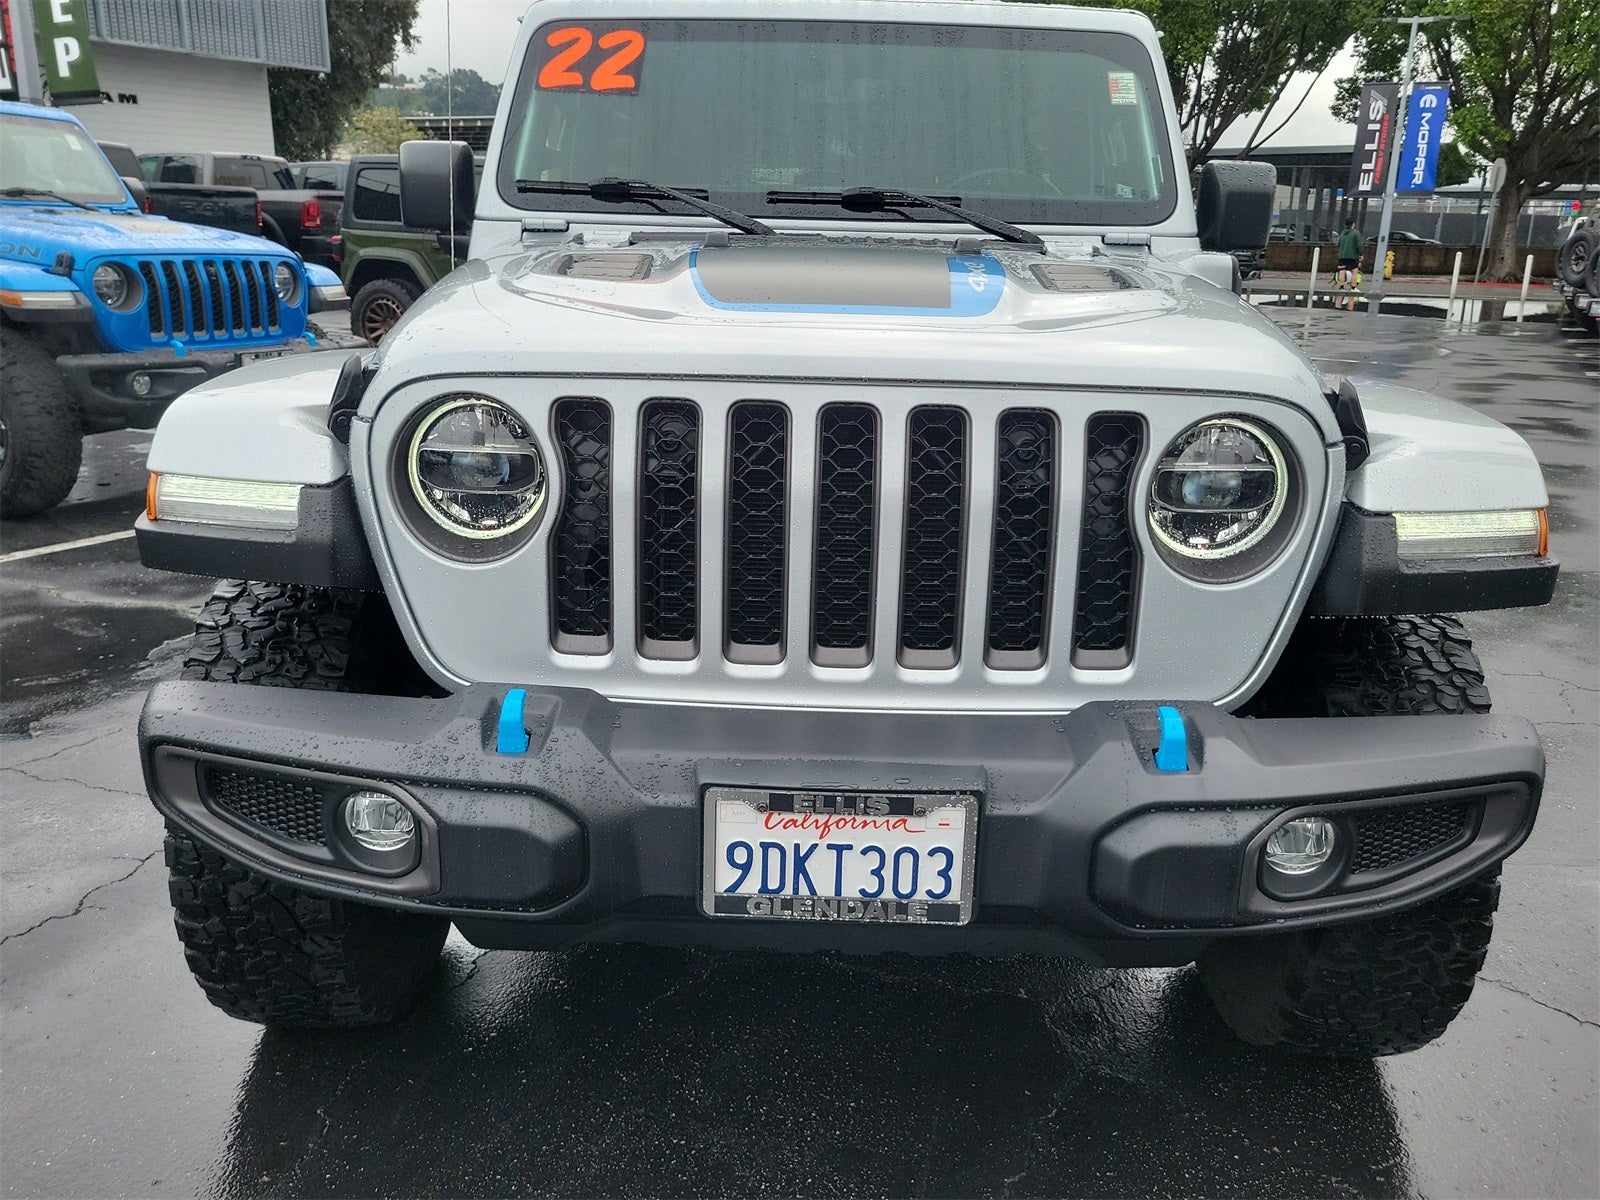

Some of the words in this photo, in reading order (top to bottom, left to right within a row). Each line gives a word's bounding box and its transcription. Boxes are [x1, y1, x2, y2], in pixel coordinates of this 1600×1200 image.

[538, 27, 645, 90] 22
[1358, 99, 1384, 191] ELLIS
[764, 812, 925, 840] California
[793, 795, 890, 816] ELLIS
[724, 840, 954, 900] 9DKT303
[746, 898, 928, 921] GLENDALE
